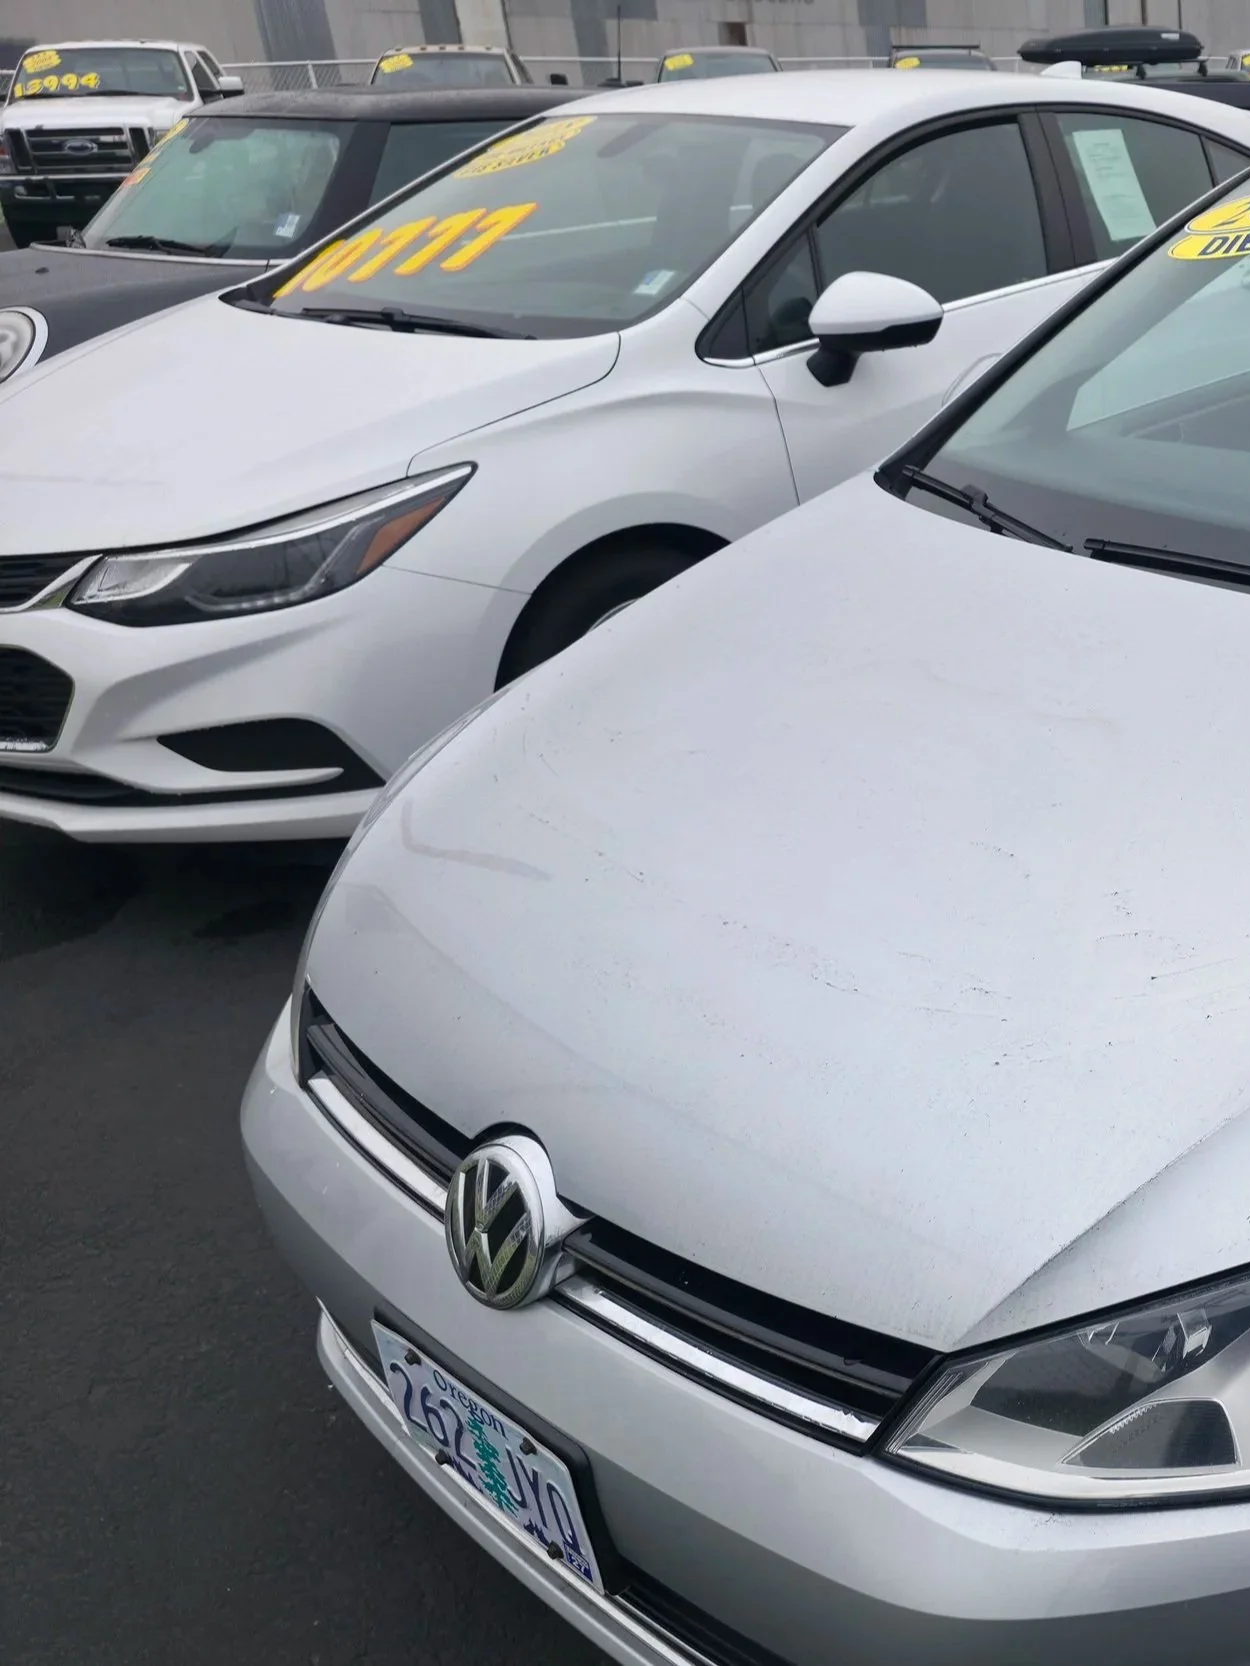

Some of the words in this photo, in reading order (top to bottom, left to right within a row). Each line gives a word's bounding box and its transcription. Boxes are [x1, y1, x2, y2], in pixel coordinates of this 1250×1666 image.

[272, 202, 538, 299] 10777
[389, 1361, 477, 1471] 262
[432, 1368, 511, 1440] Oregon
